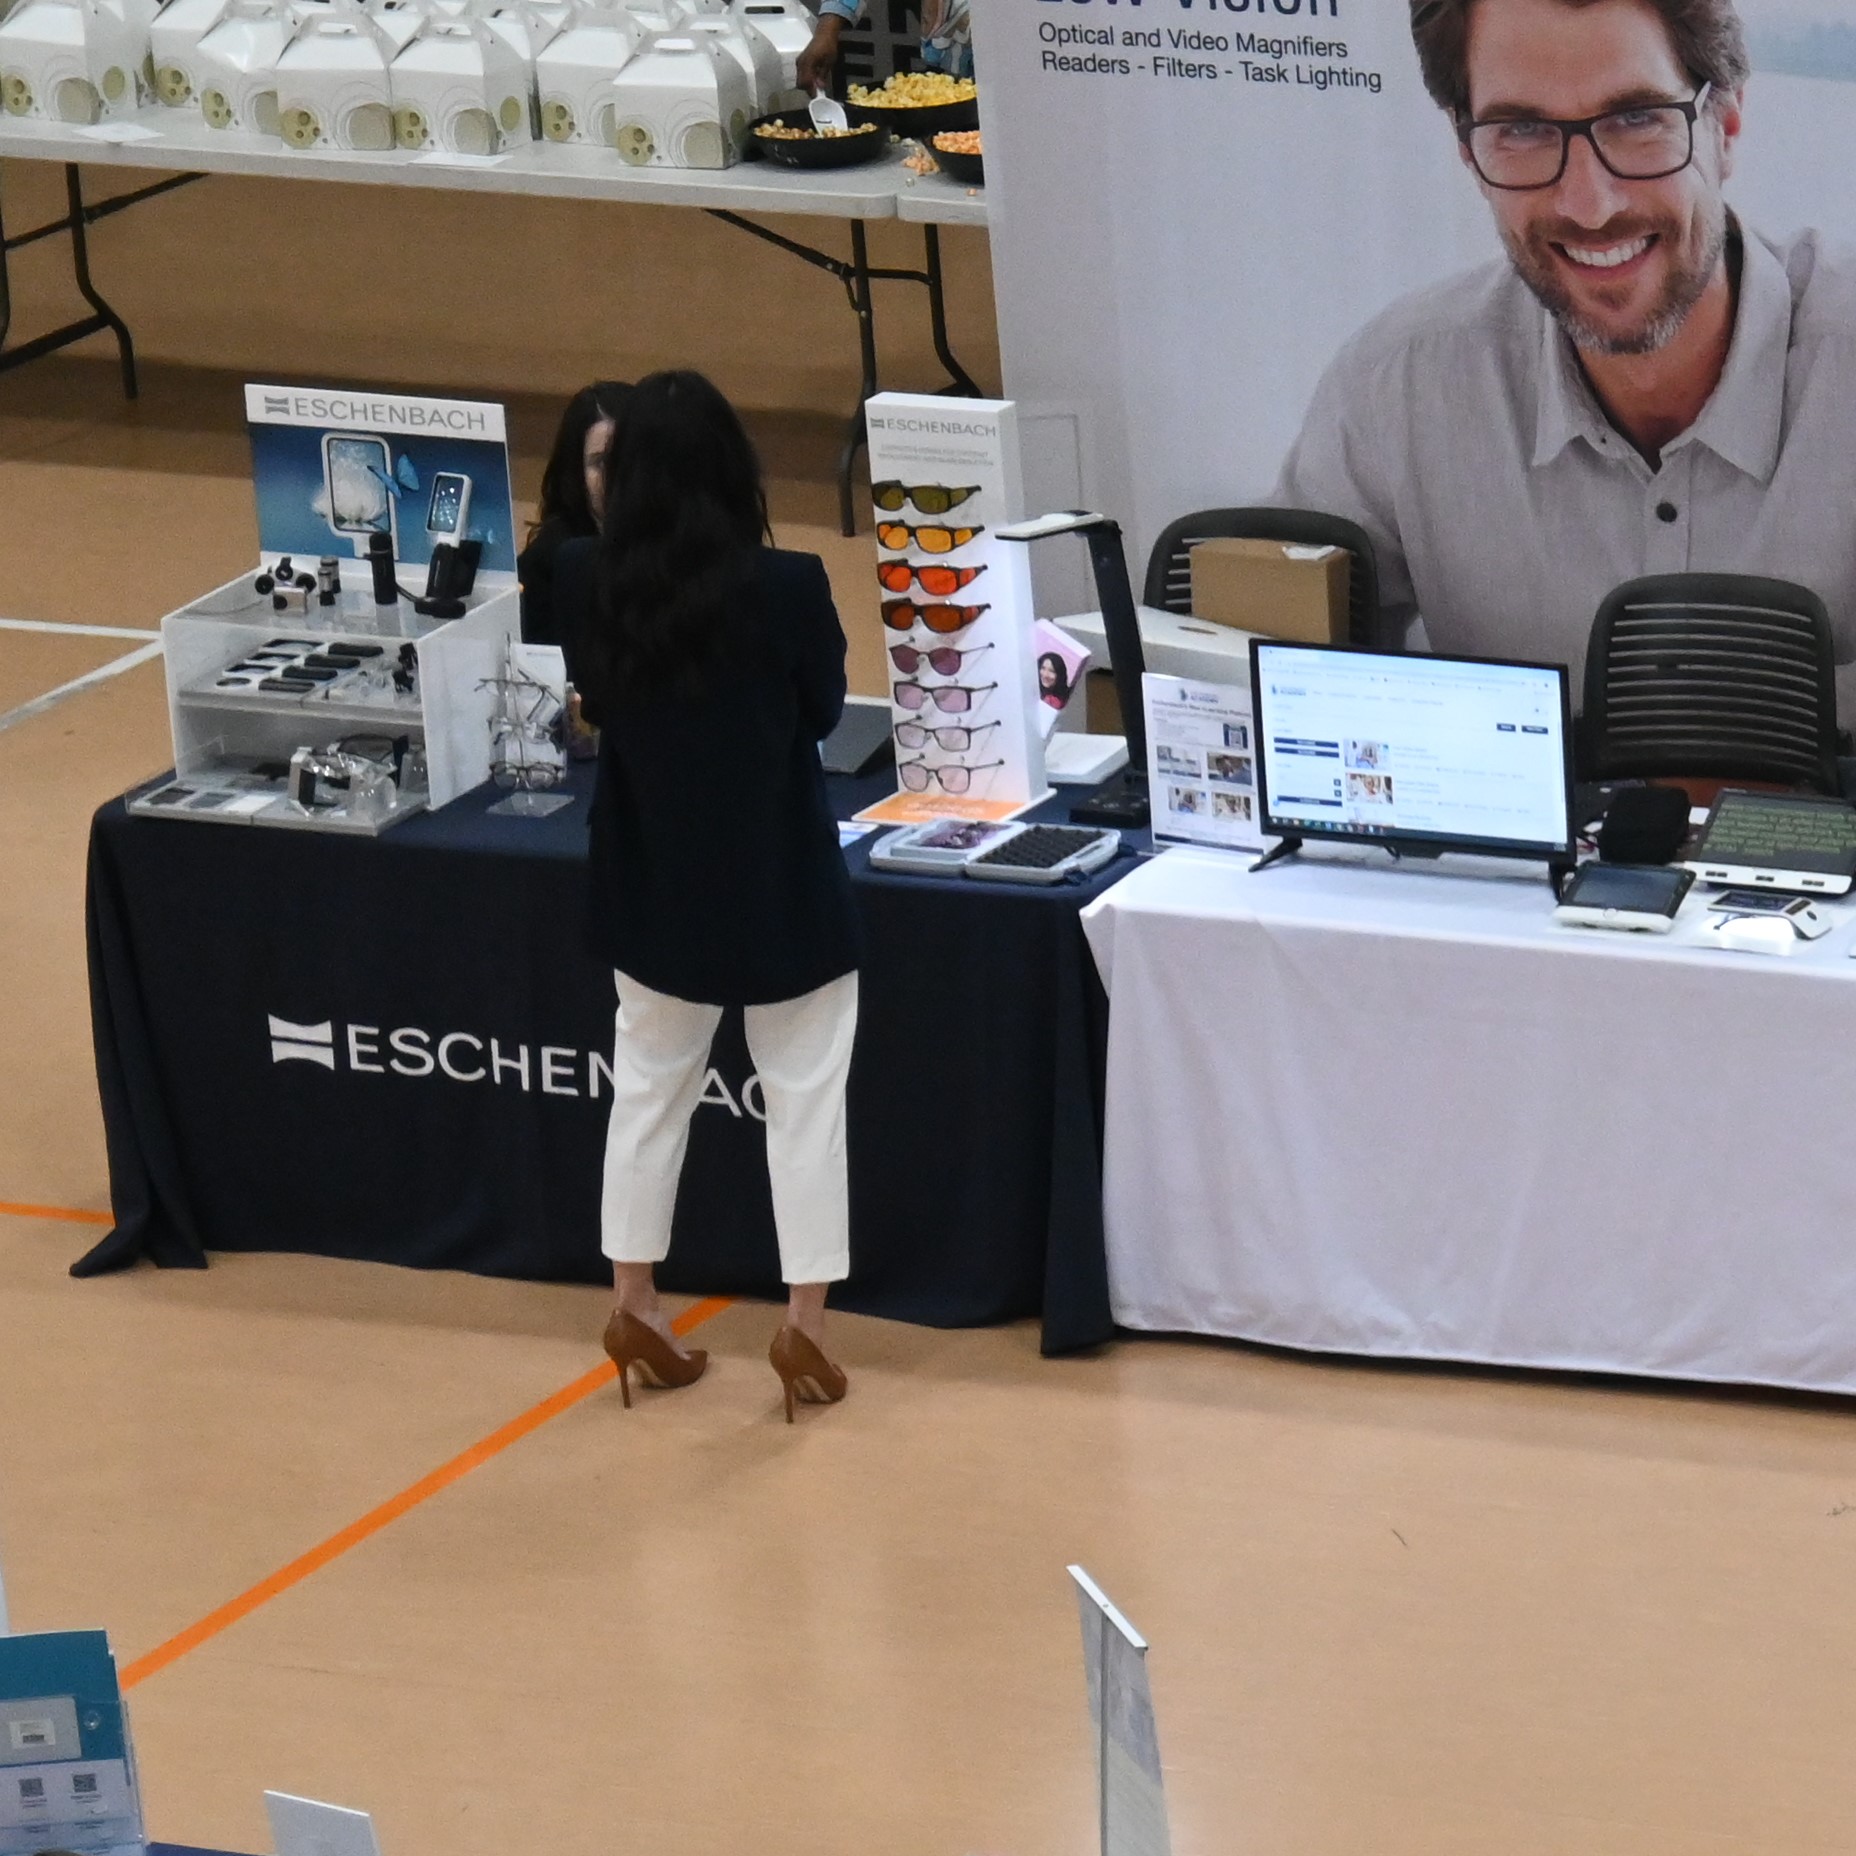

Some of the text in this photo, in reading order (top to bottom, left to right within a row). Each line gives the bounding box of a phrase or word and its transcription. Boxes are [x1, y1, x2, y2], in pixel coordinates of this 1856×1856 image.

[1039, 22, 1348, 60] Optical and Video Magnifiers
[1042, 51, 1130, 74] Readers
[1153, 56, 1218, 79] Filters
[1239, 61, 1289, 84] Task
[1295, 65, 1382, 93] Lighting
[294, 397, 485, 431] ESCHENBACH
[886, 418, 996, 437] ESCHENBACH
[347, 1024, 766, 1122] ESCHENAC
